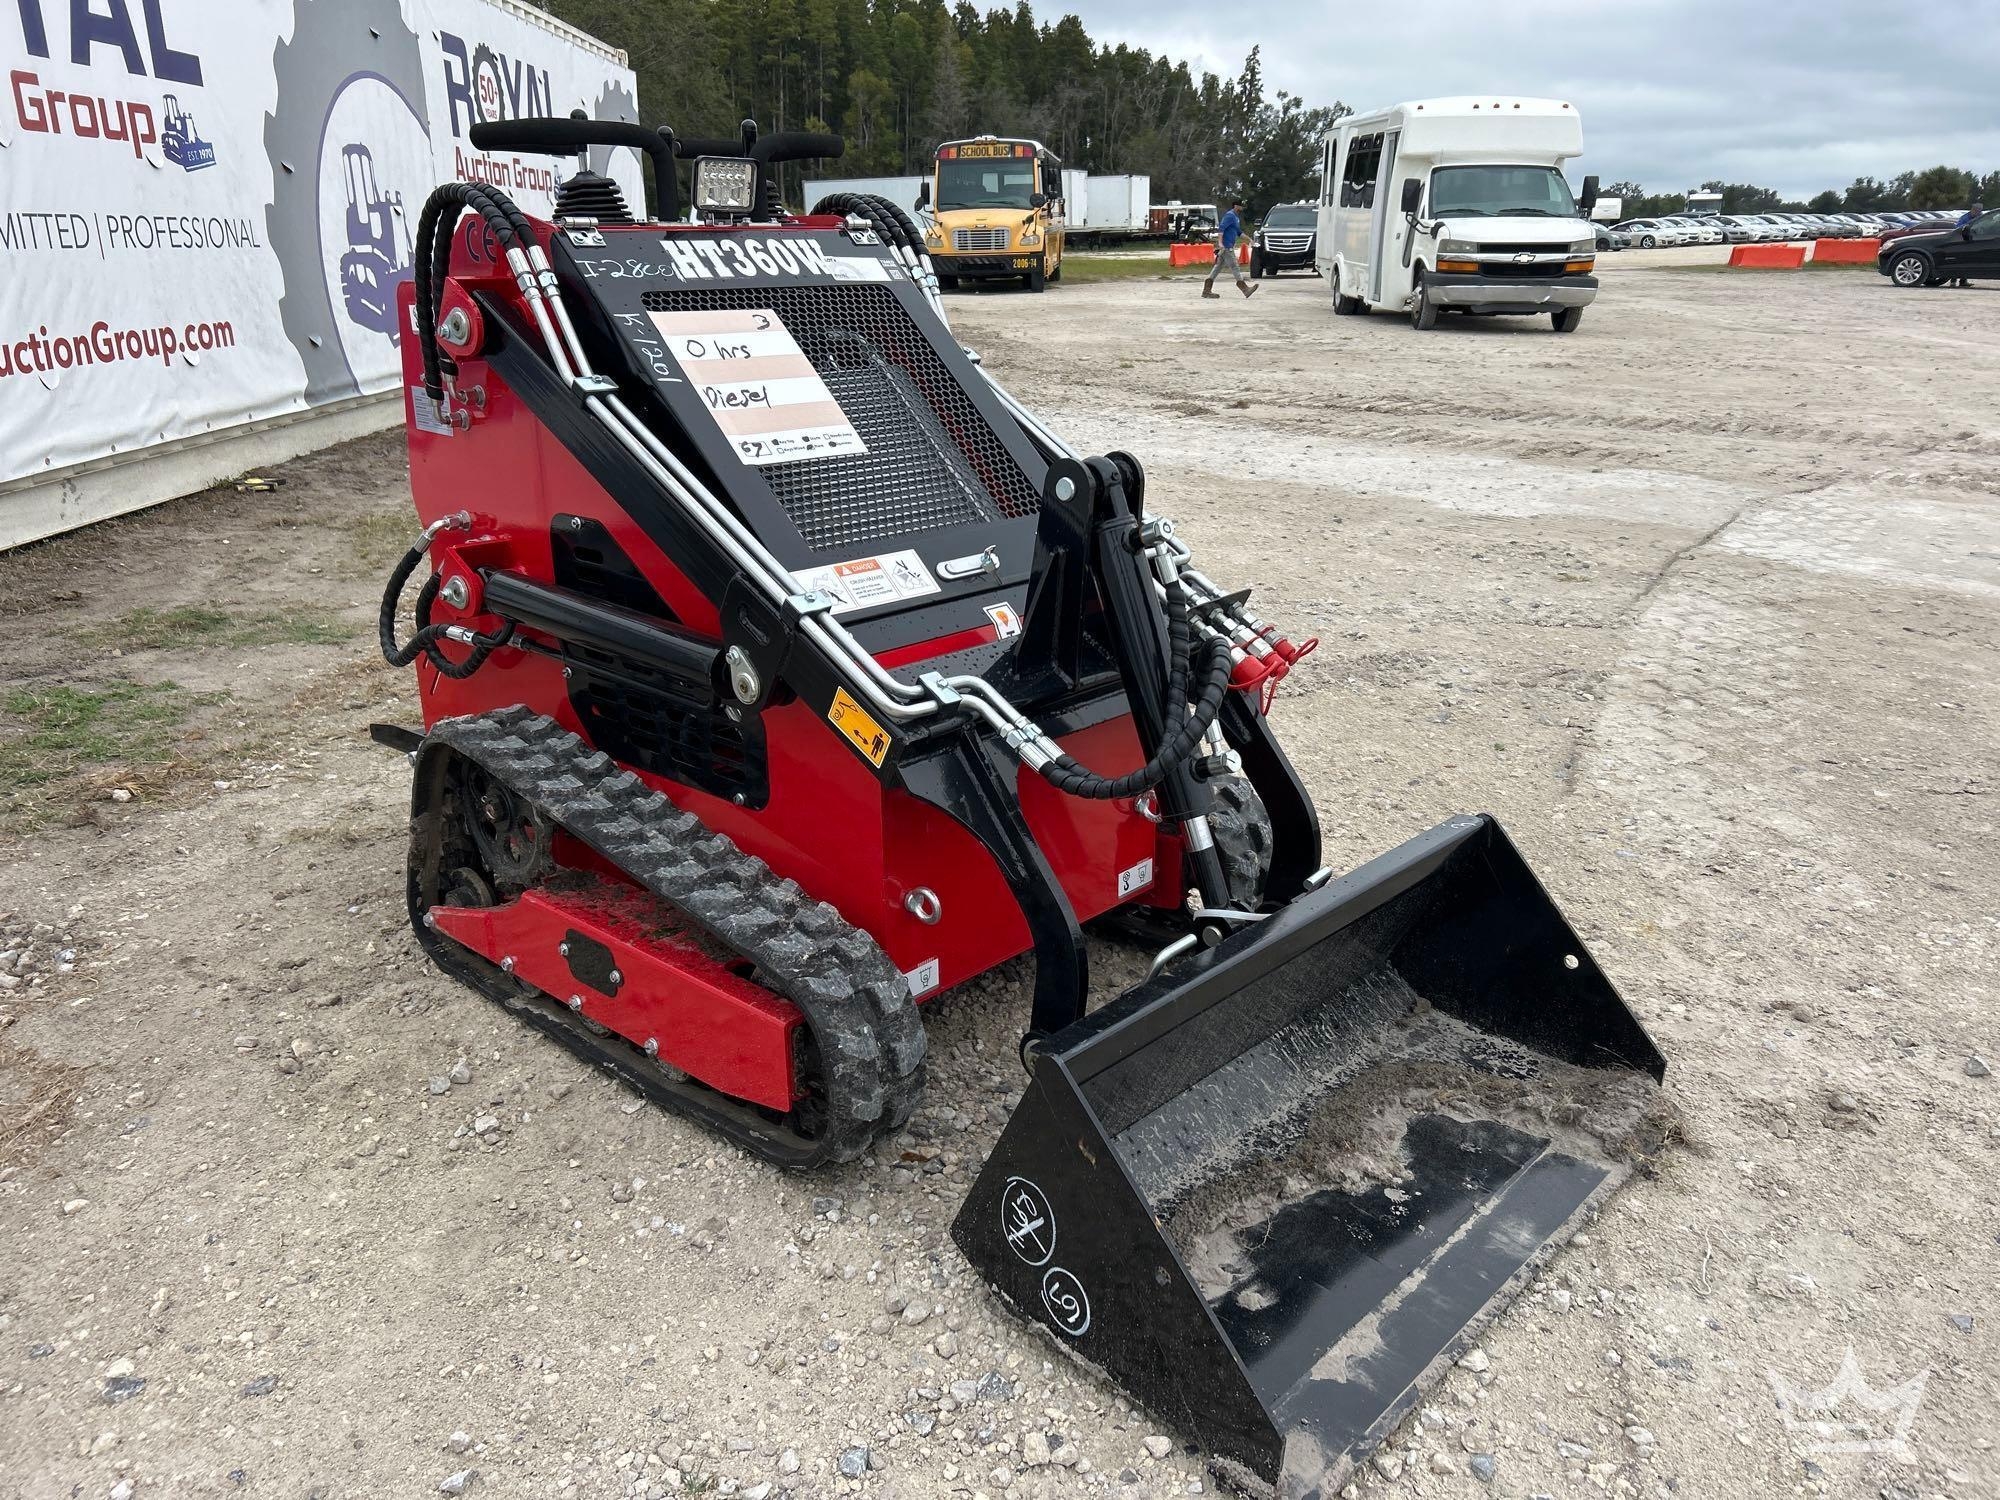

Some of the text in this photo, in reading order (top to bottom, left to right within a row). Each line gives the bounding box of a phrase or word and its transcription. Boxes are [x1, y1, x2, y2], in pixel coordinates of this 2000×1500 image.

[480, 74, 498, 105] 50+
[10, 69, 157, 159] Group
[199, 148, 213, 159] 1970
[961, 145, 1008, 157] SCHOOL BUS
[456, 145, 553, 201] Auction Group
[106, 214, 261, 249] PROFESSIONAL
[659, 238, 831, 279] HT360W
[752, 314, 771, 330] 3
[0, 320, 236, 378] uctionGroup.com
[714, 340, 751, 360] hrs
[702, 385, 772, 409] Diesel
